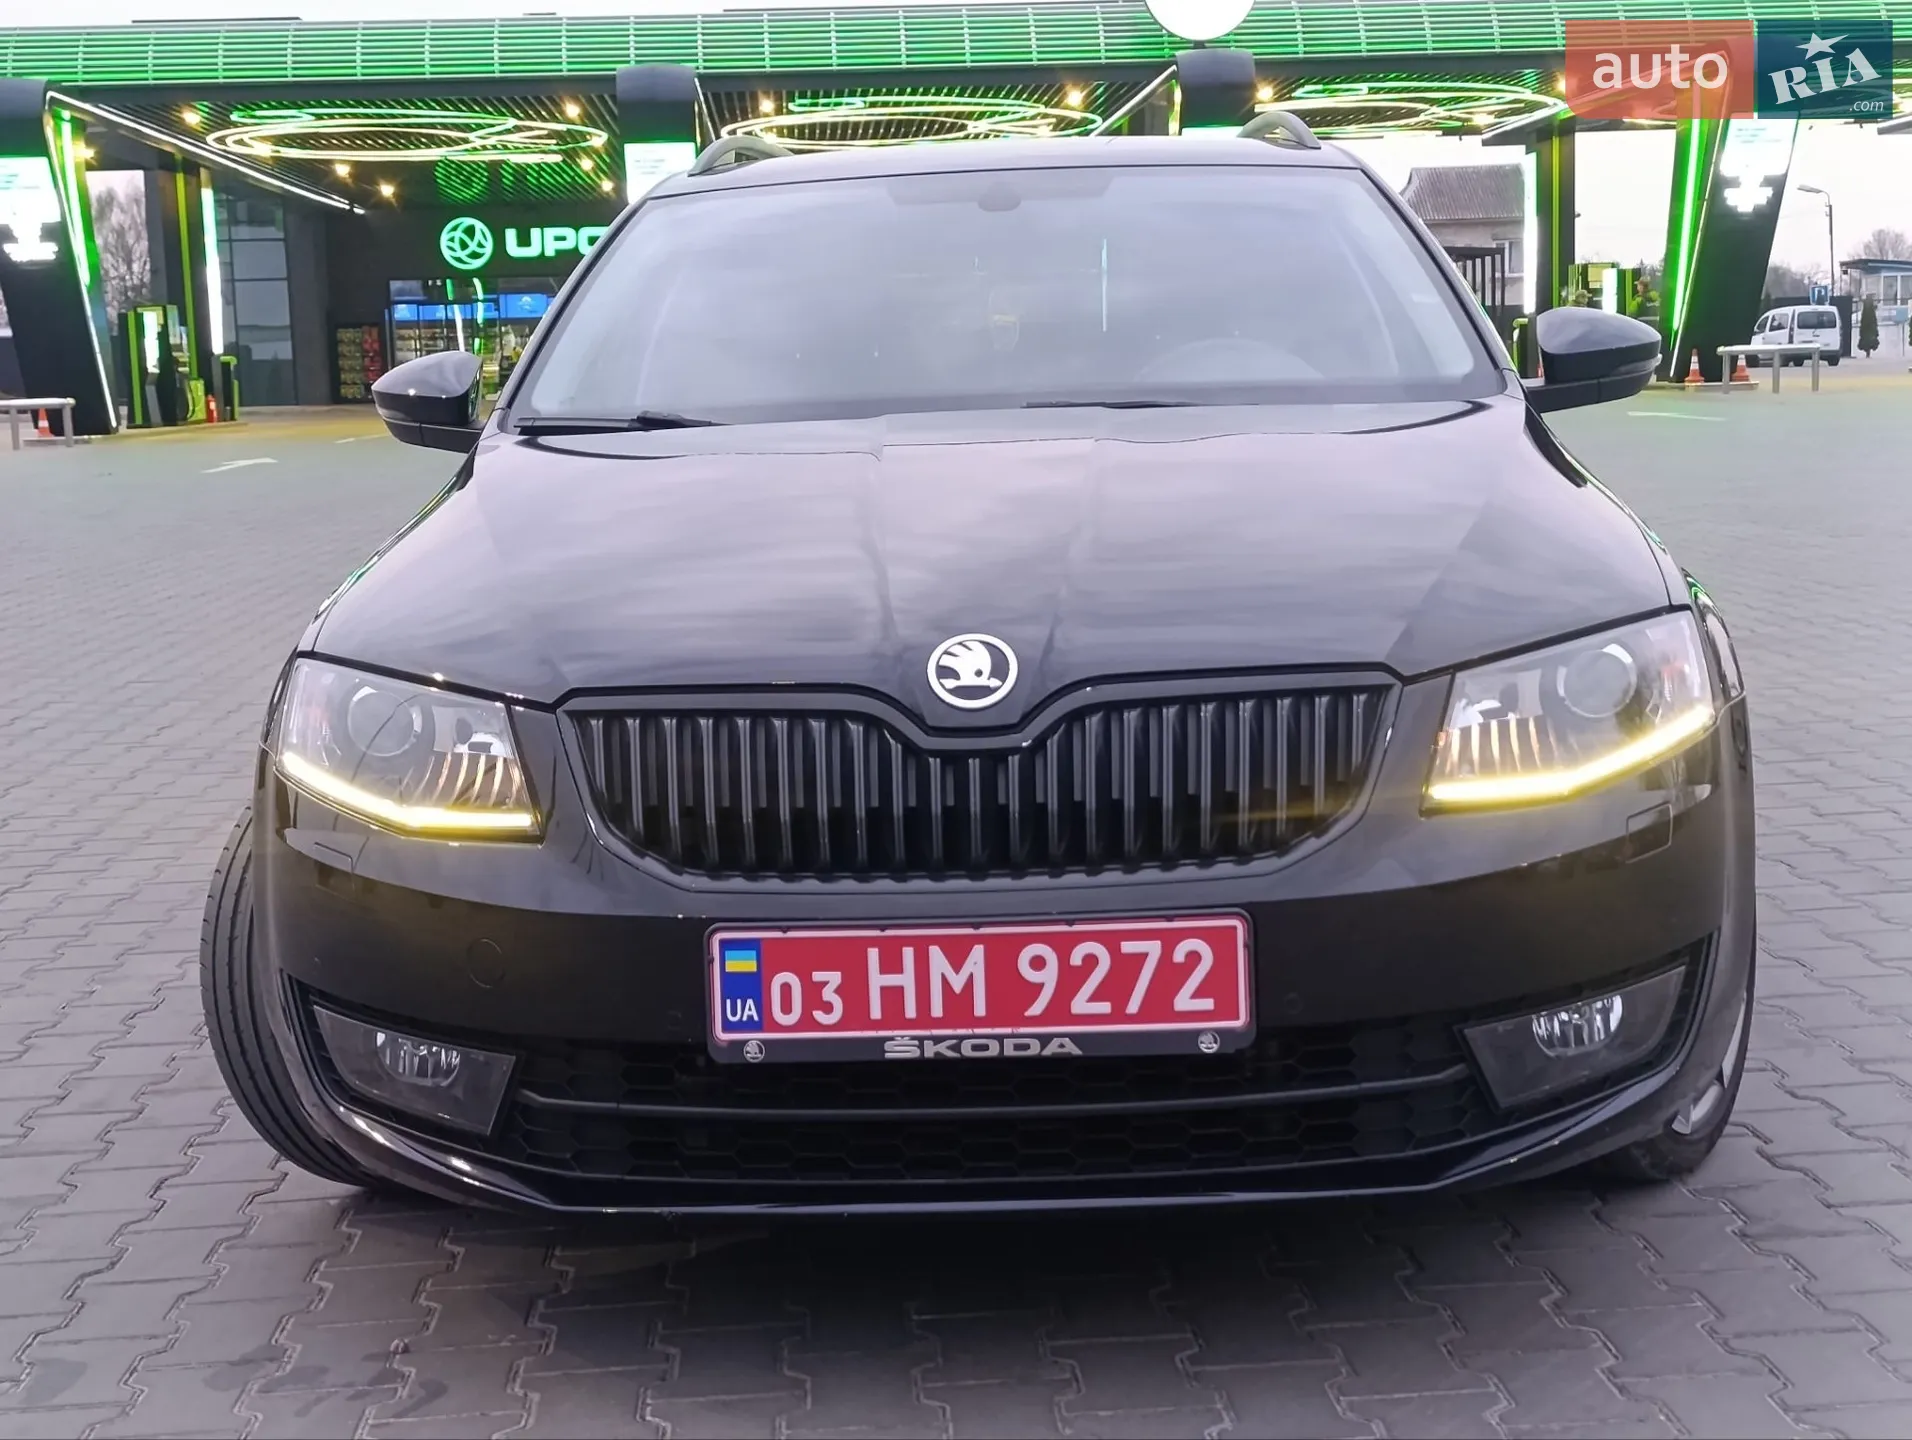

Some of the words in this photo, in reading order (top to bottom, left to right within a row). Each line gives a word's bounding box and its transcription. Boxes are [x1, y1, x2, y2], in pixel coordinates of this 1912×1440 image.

[770, 971, 844, 1026] 03
[867, 944, 987, 1020] HM
[1017, 938, 1215, 1017] 9272
[725, 998, 759, 1022] UA
[884, 1036, 1083, 1059] ŠKODA
